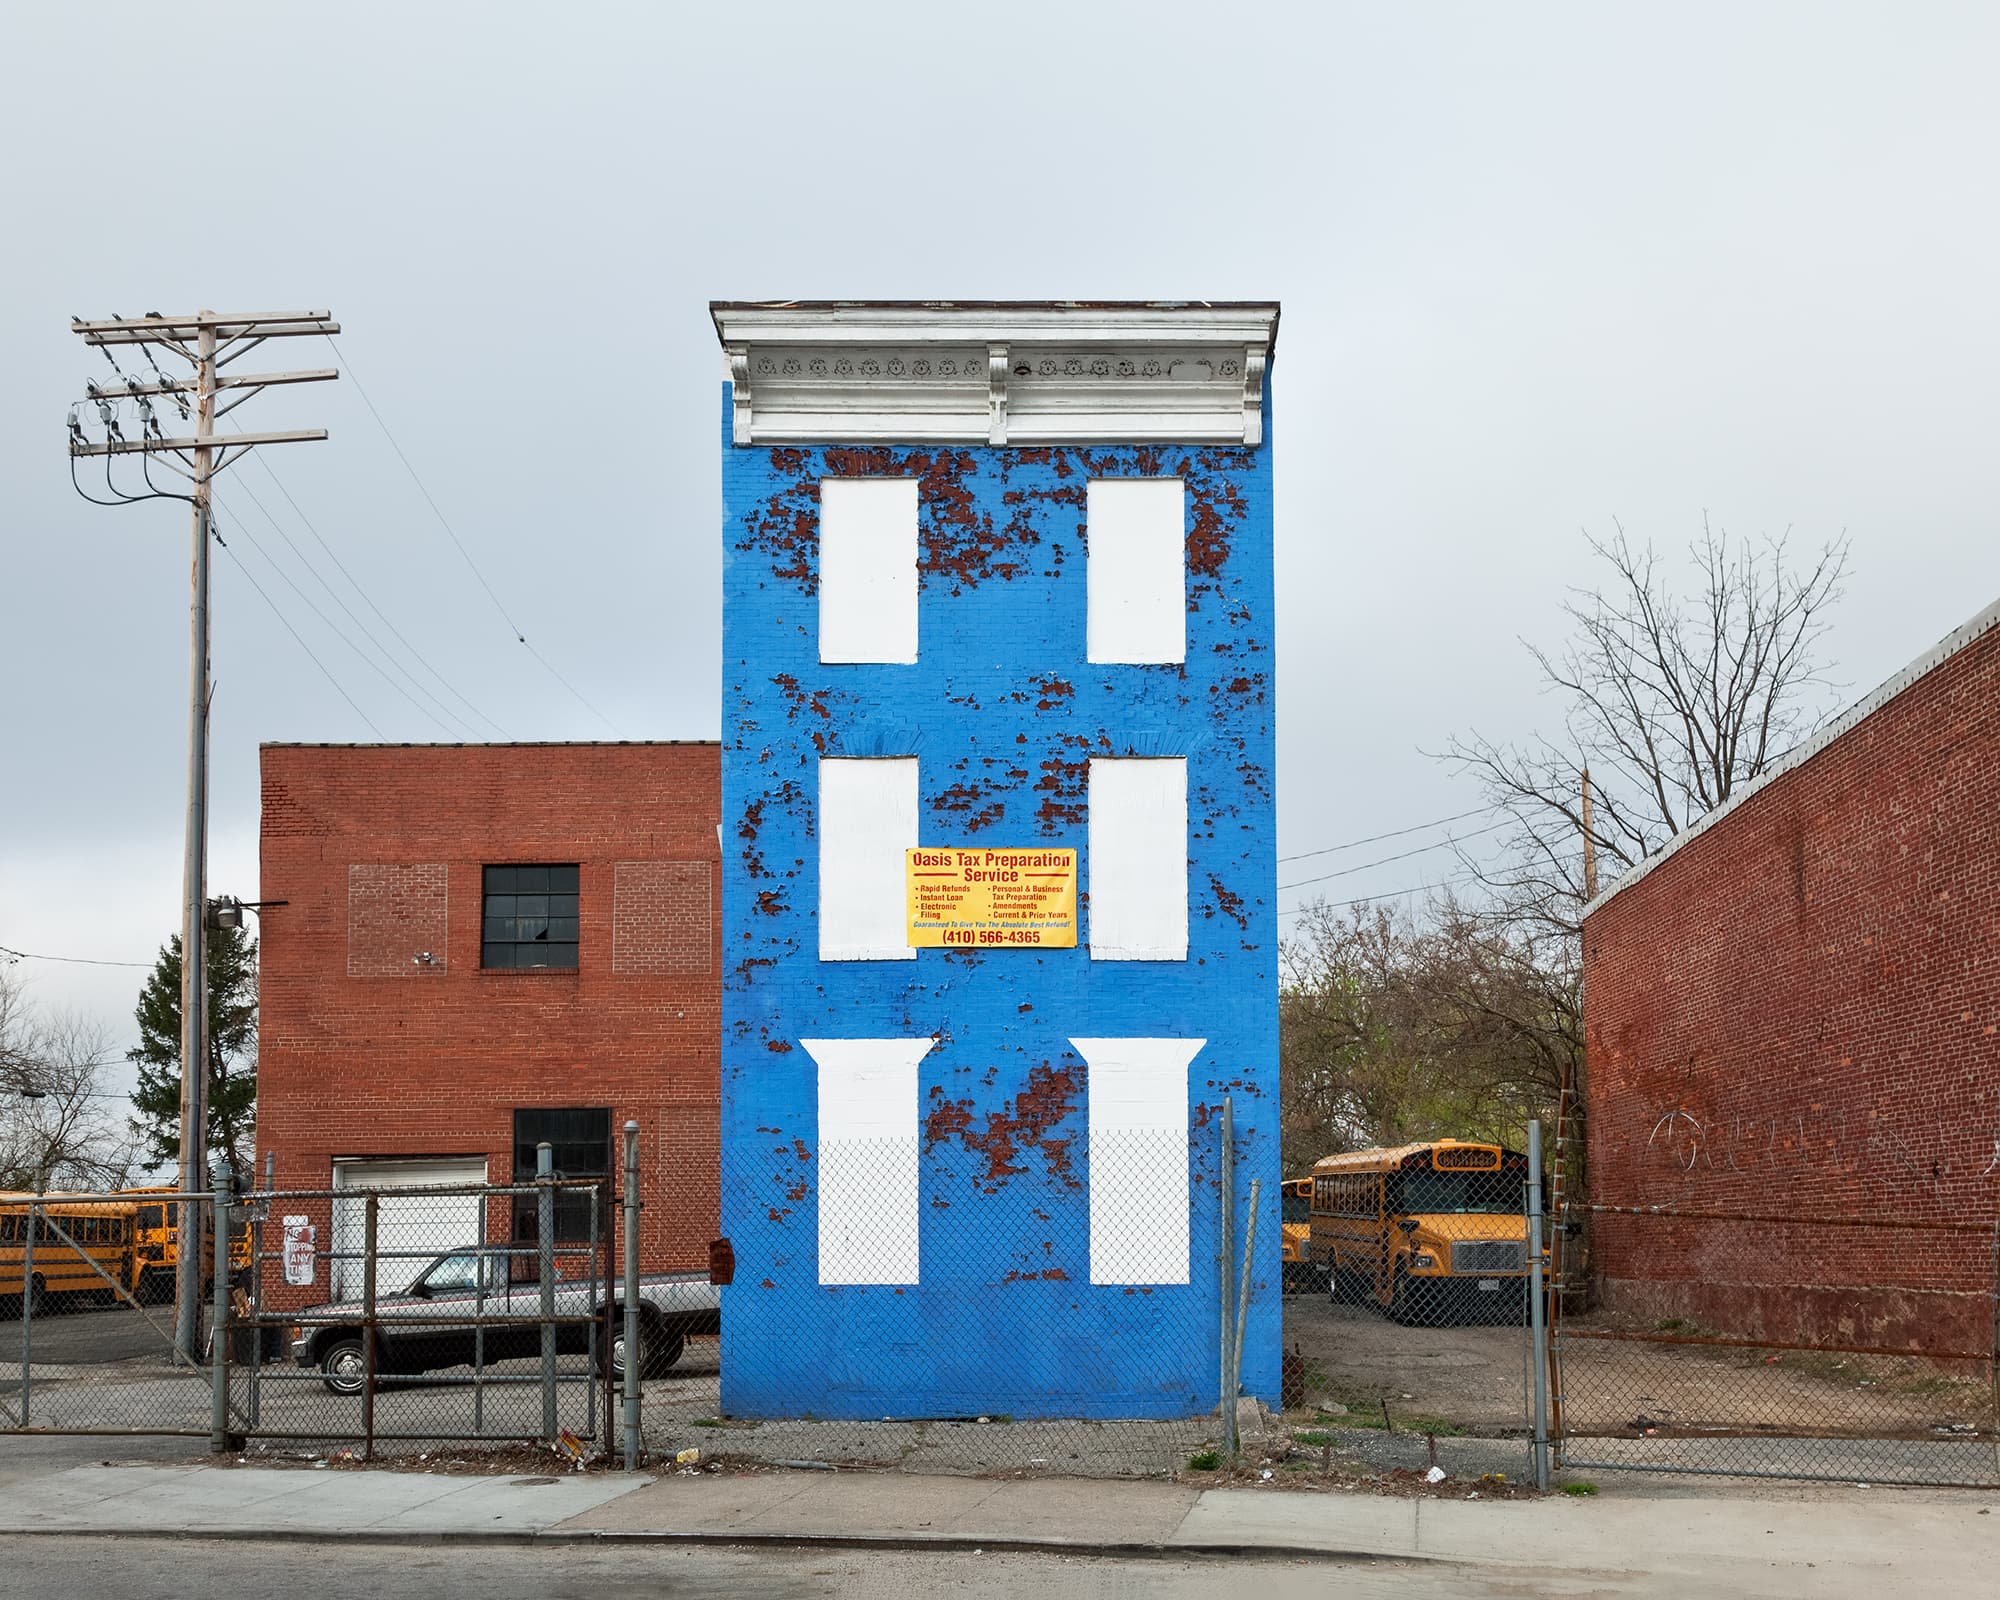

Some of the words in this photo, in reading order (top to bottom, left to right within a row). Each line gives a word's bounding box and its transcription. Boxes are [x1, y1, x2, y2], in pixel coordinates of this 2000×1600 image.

[913, 852, 952, 866] Oasis
[956, 852, 980, 866] Tax
[985, 852, 1070, 869] Preparation
[964, 867, 1018, 882] Service
[920, 885, 940, 893] Rapid
[1032, 885, 1064, 893] Business
[1006, 893, 1047, 902] Preparation
[992, 902, 1038, 910] Amendments
[920, 911, 941, 919] Filing
[1029, 911, 1046, 919] Prior
[943, 929, 975, 945] (410)
[979, 930, 1041, 944] 566-4365
[289, 1254, 310, 1263] ANY
[289, 1265, 311, 1275] TIME
